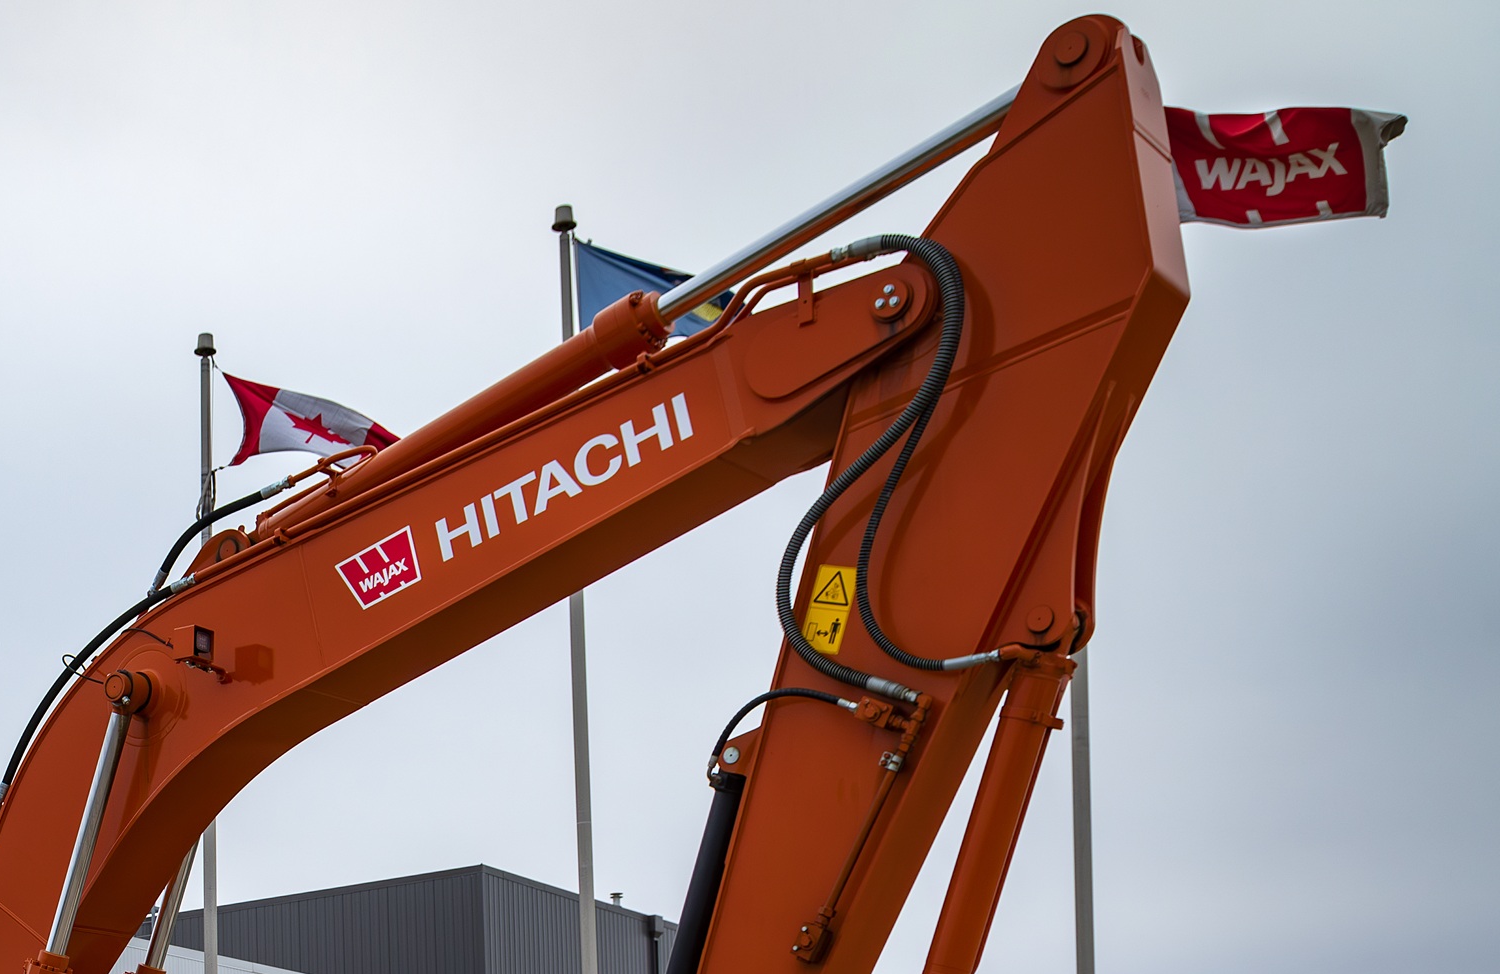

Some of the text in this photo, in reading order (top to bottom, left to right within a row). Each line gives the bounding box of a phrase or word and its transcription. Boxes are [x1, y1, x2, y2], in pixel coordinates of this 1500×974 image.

[1195, 142, 1347, 196] WAJAX
[435, 392, 694, 562] HITACHI
[358, 557, 409, 594] WAJAX
